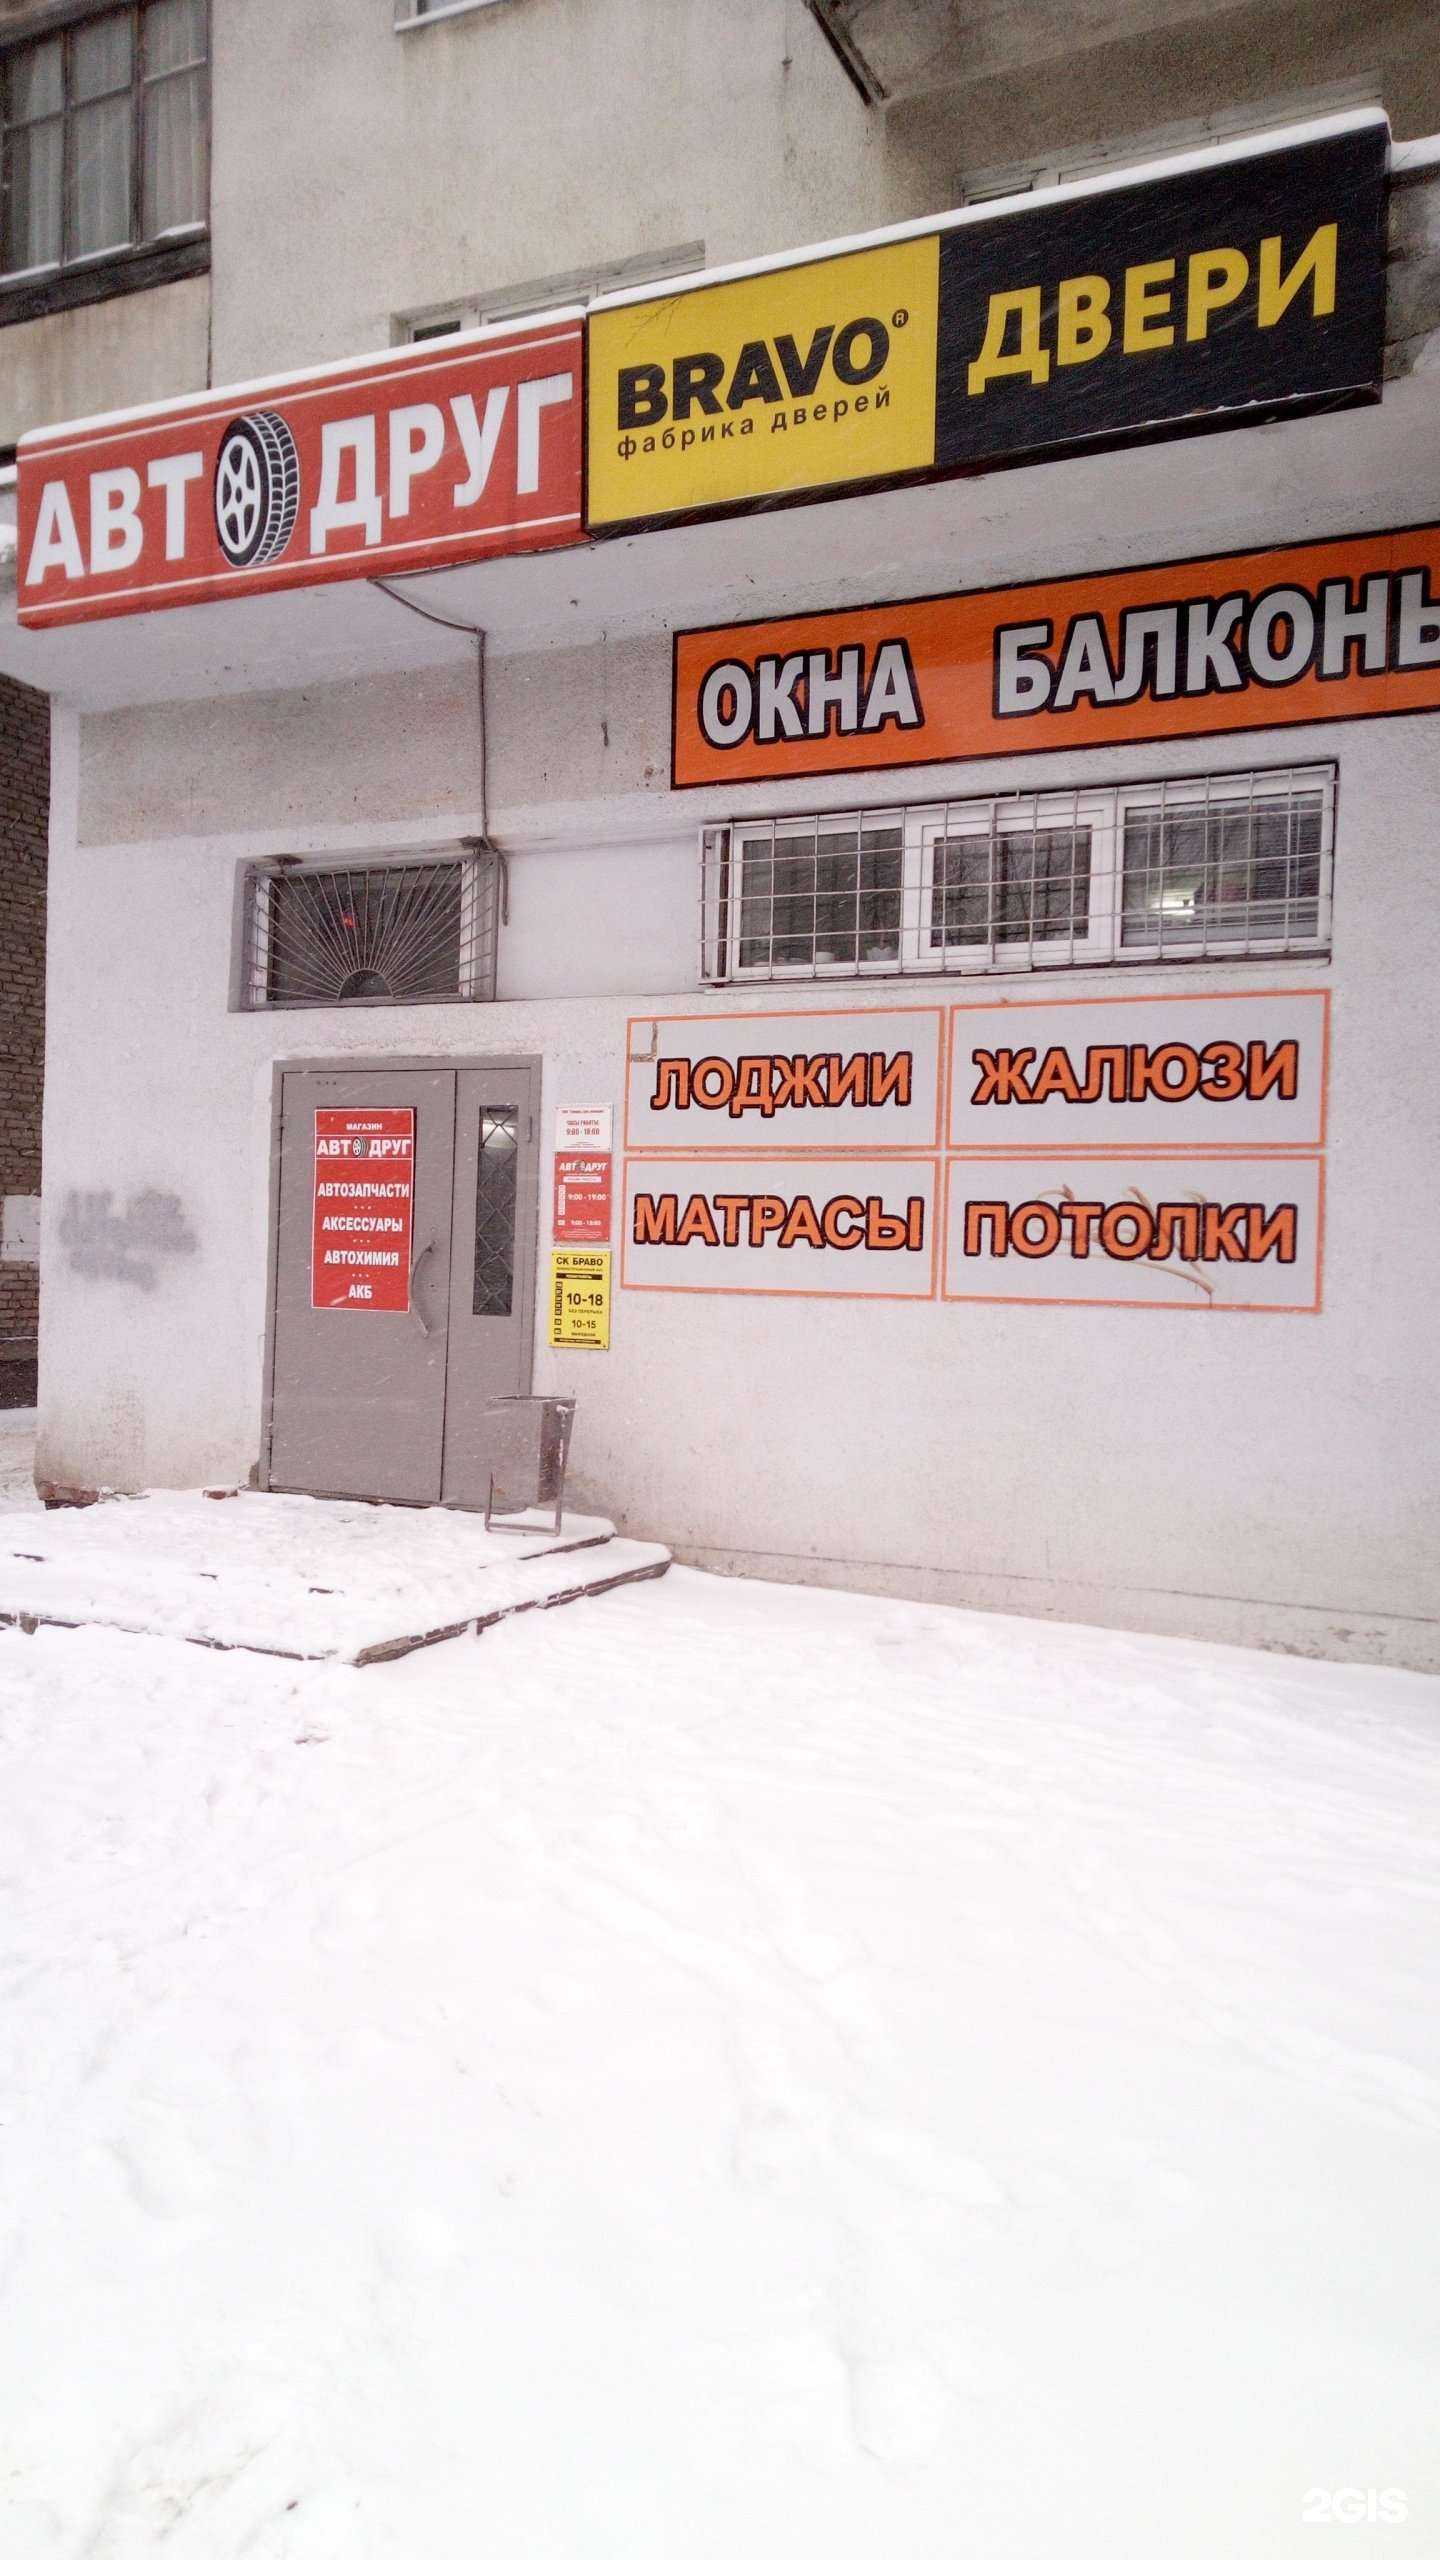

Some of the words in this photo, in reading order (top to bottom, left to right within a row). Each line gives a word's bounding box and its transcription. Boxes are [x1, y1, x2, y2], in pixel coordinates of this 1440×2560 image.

[967, 223, 1339, 397] ДВЕРИ
[617, 316, 891, 432] BRAVO
[616, 415, 756, 461] фабрика
[770, 386, 894, 436] дверей
[310, 372, 573, 554] ДРУГ
[698, 636, 925, 750] ОКНА
[649, 1051, 914, 1118] ЛОДЖИИ
[970, 1038, 1300, 1106] ЖАЛЮЗИ
[346, 1122, 383, 1131] МАГАЗИН
[368, 1139, 412, 1158] ДРУГ
[317, 1183, 410, 1198] АВТОЗАПЧАСТИ
[322, 1216, 403, 1232] АКСЕССУАРЫ
[633, 1194, 925, 1251] МАТРАСЫ
[964, 1201, 1298, 1262] ПОТОЛКИ
[324, 1250, 400, 1266] АВТОХИМИЯ
[556, 1256, 569, 1265] СК
[572, 1257, 604, 1266] БРАВО
[348, 1285, 373, 1299] АКБ
[566, 1292, 604, 1306] 10-18
[571, 1319, 597, 1329] 10-15
